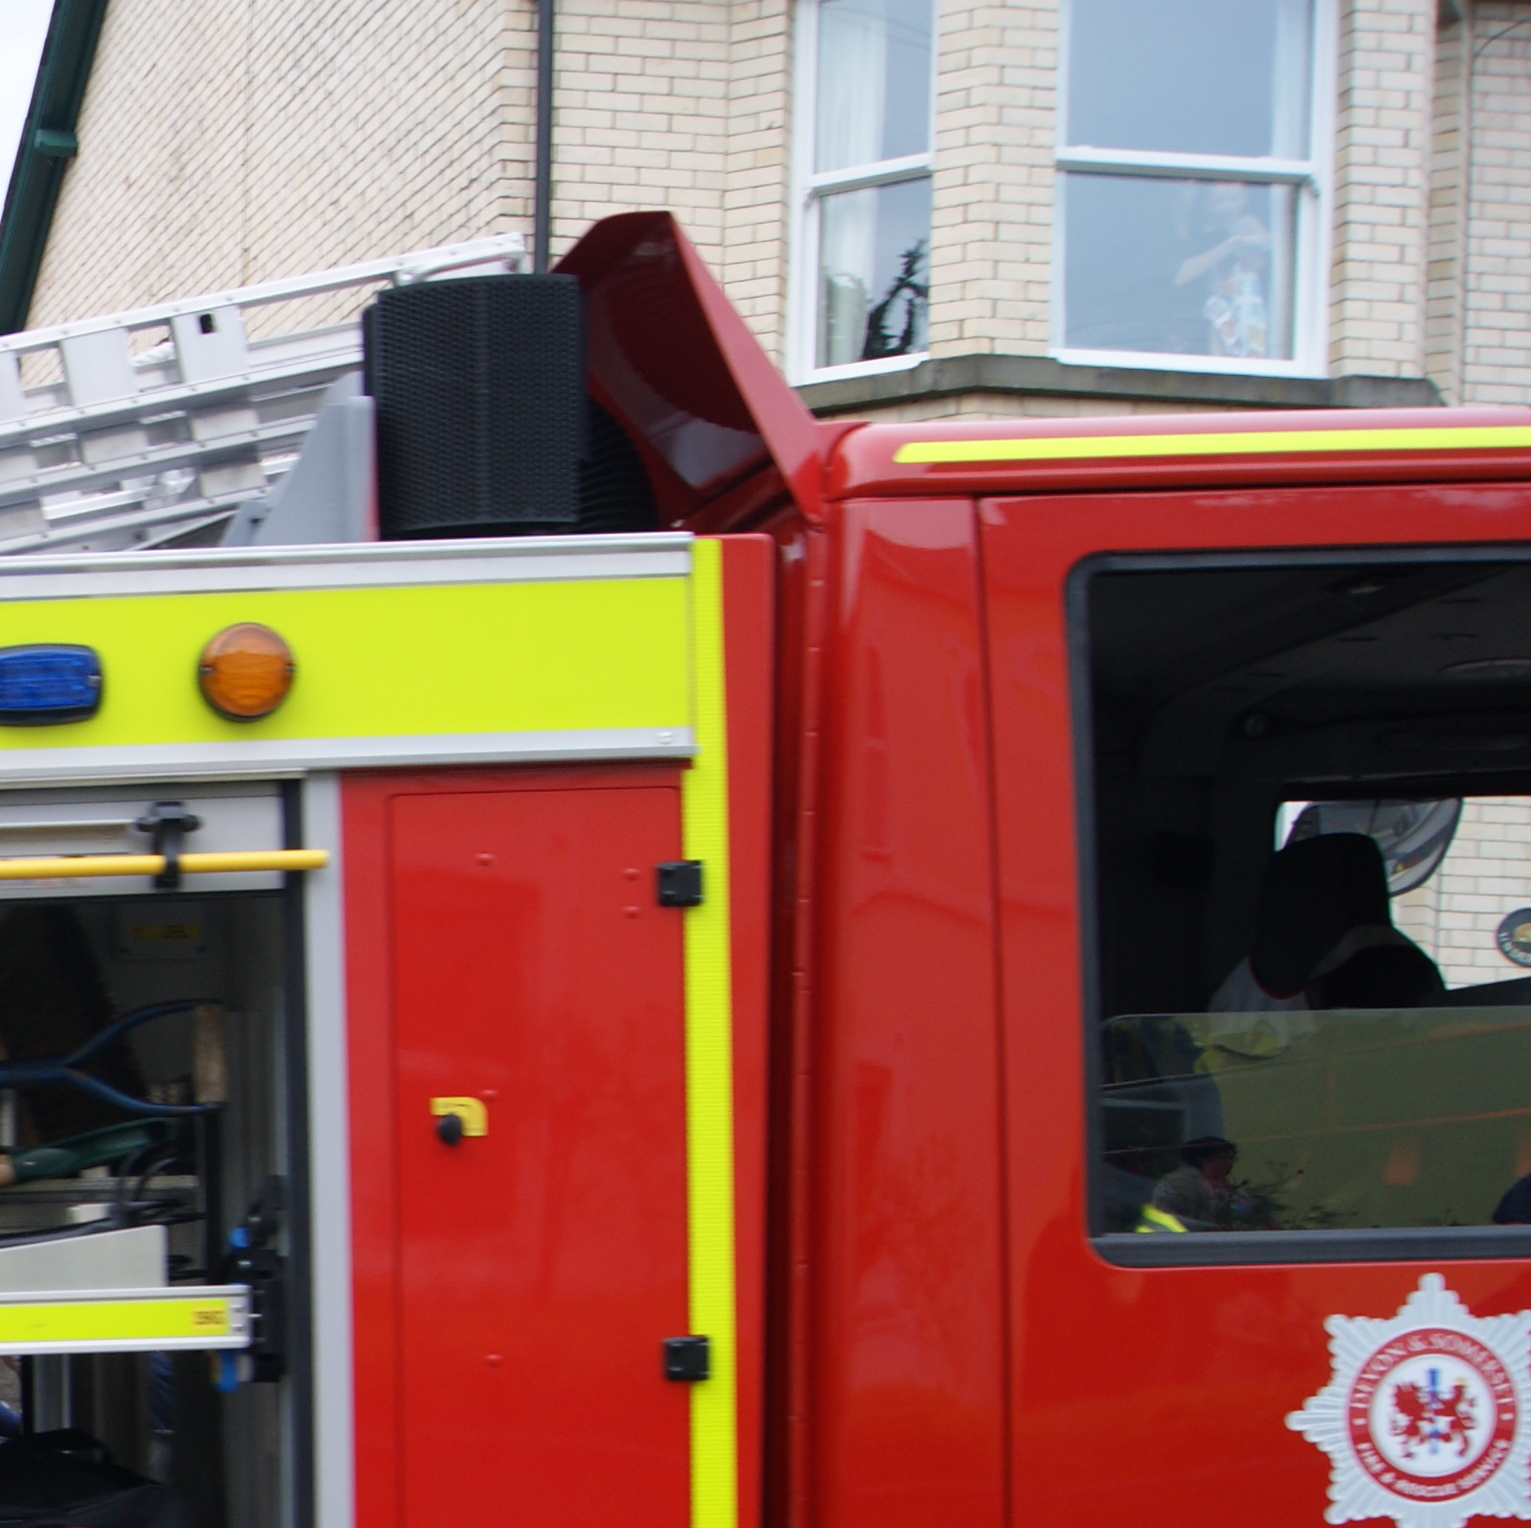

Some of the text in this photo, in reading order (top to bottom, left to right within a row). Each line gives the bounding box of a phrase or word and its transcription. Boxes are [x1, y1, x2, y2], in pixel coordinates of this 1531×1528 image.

[1349, 1333, 1515, 1408] DEVON & SOMERSET
[1356, 1441, 1388, 1474] FIRE
